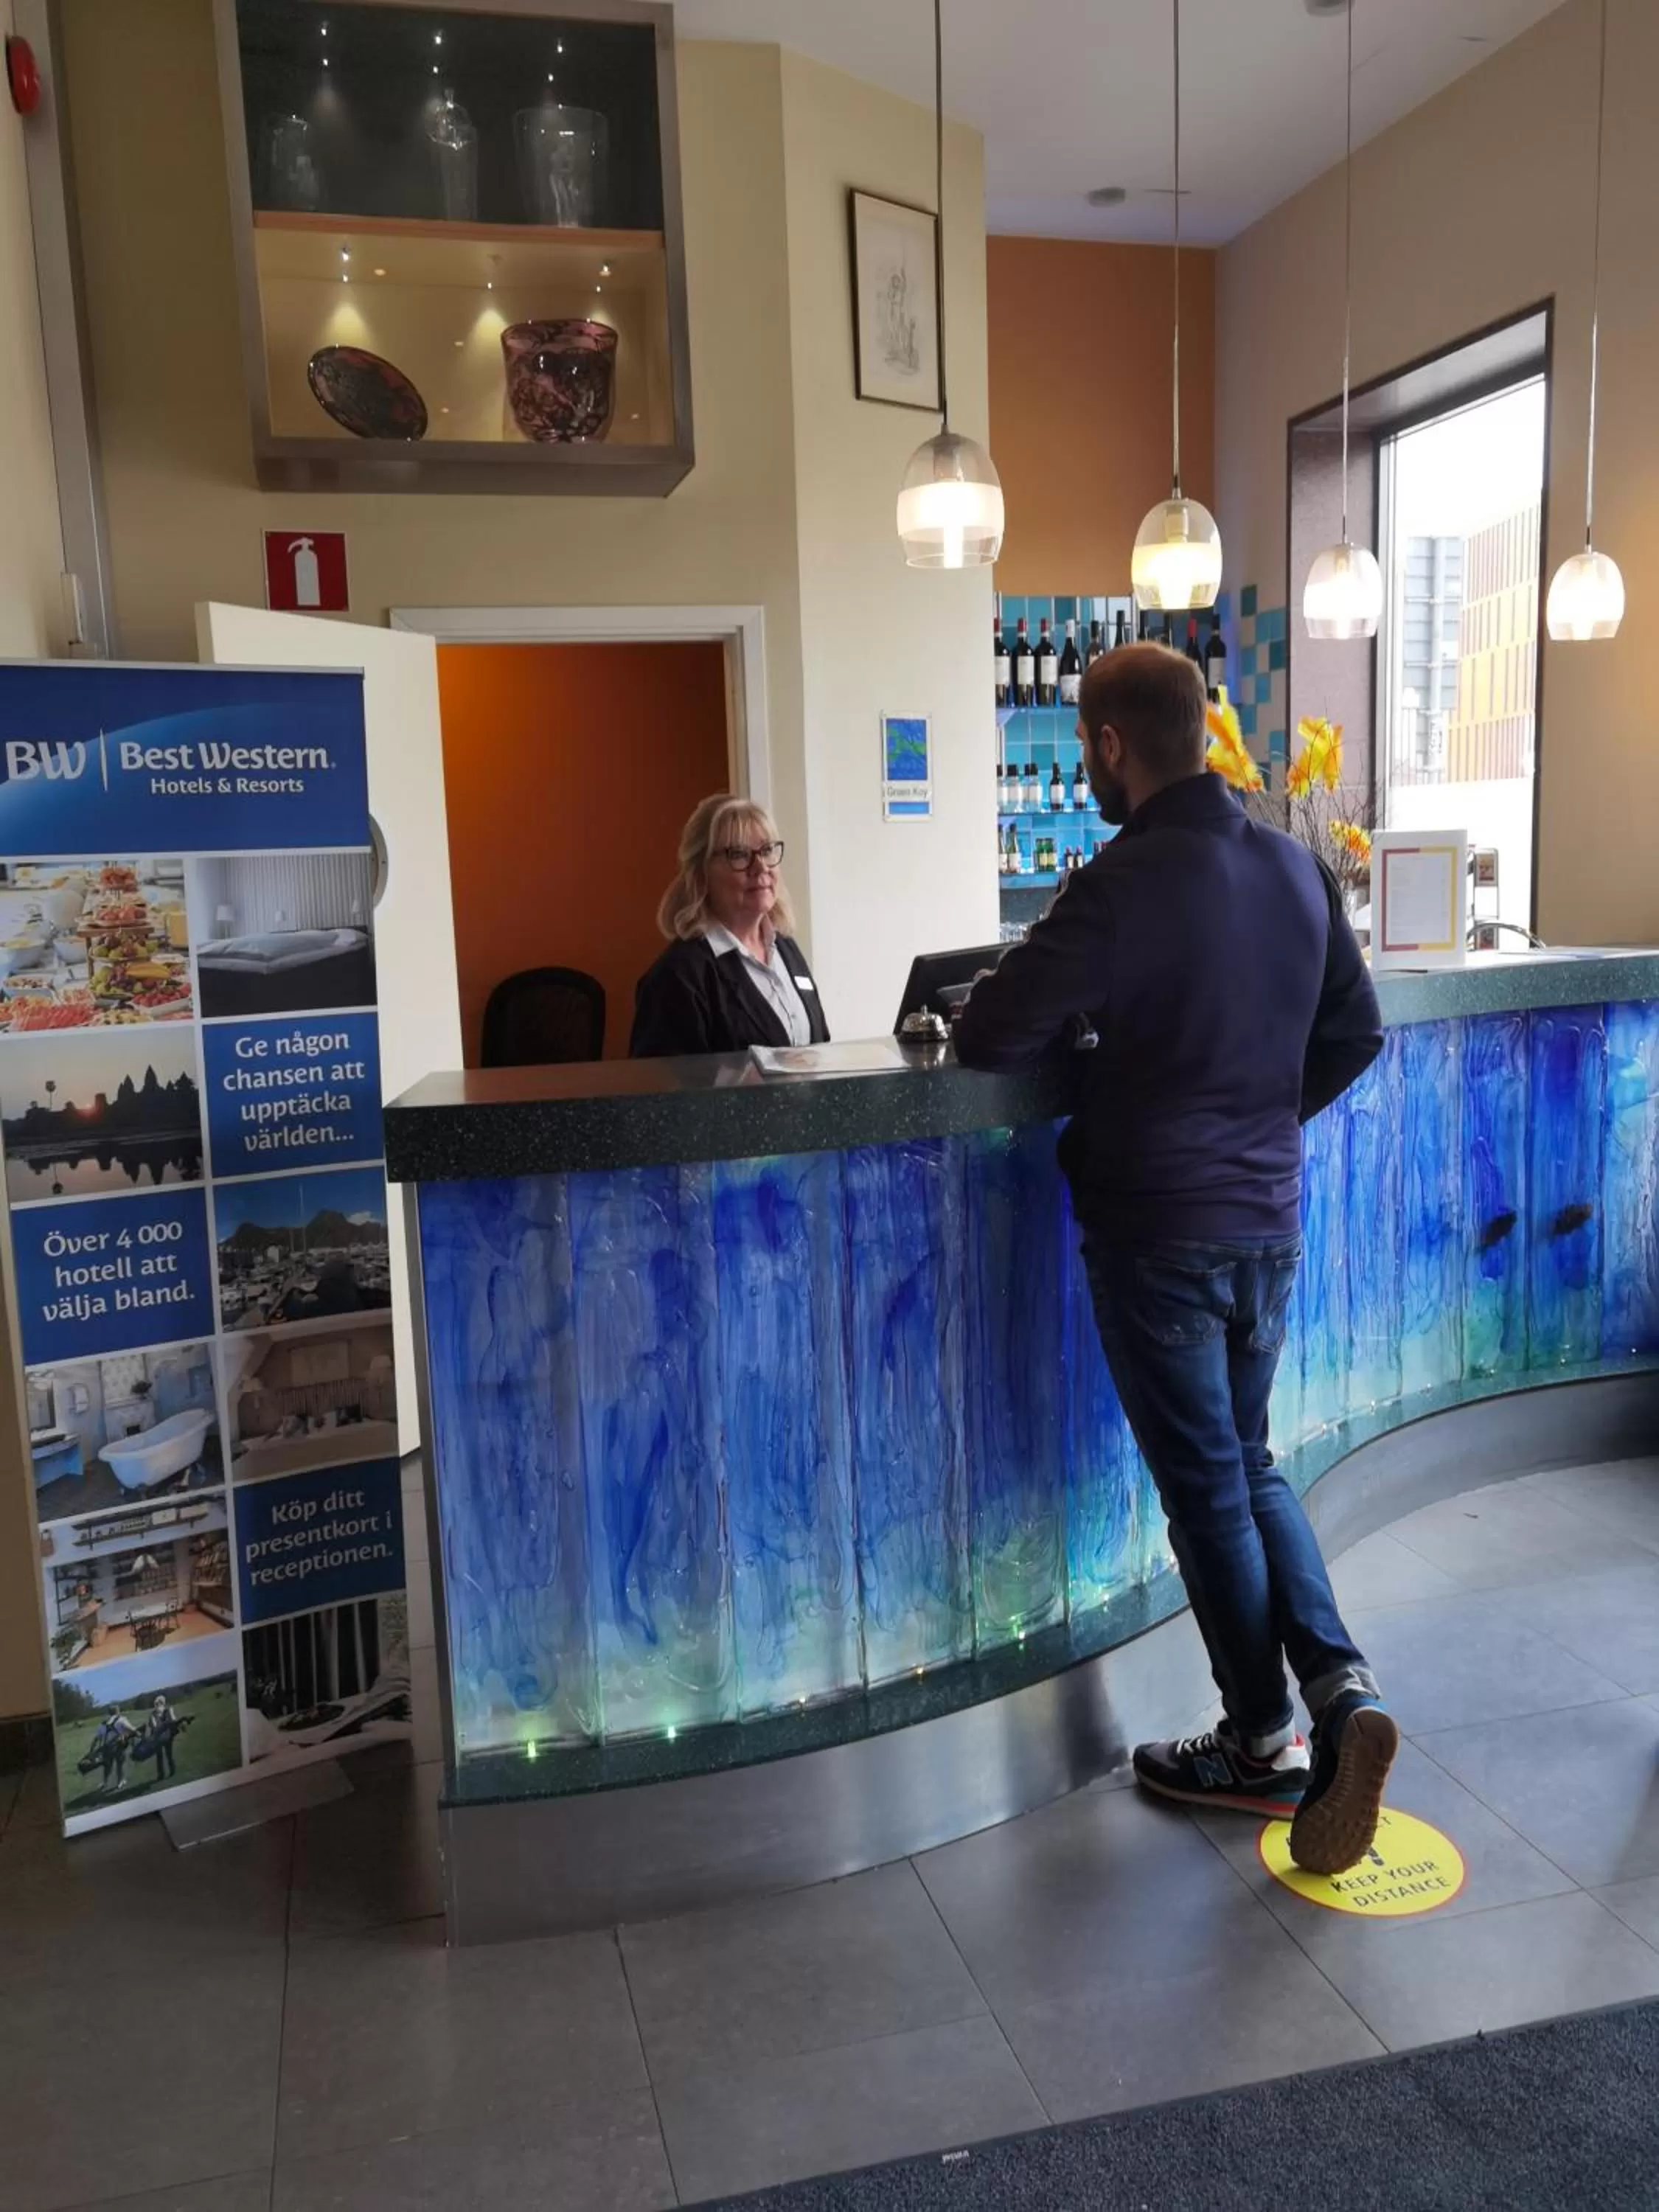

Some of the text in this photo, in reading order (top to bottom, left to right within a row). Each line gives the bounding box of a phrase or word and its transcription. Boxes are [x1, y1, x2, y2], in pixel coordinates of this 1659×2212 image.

[6, 741, 86, 780] BW
[119, 741, 193, 770] Best
[151, 777, 305, 793] Hotels & Resorts
[235, 1030, 349, 1058] Ge någon
[223, 1061, 366, 1091] chansen att
[240, 1090, 352, 1123] upptäcka
[244, 1124, 355, 1151] världen...
[43, 1221, 184, 1257] Över 4 000
[55, 1254, 178, 1288] hotell att
[42, 1279, 196, 1322] välja bland.
[271, 1490, 366, 1526] Köp ditt
[245, 1510, 393, 1564] presentkort i
[250, 1543, 394, 1587] receptionen.
[1330, 1860, 1437, 1893] KEEP YOUR
[1353, 1877, 1450, 1908] DISTANCE
